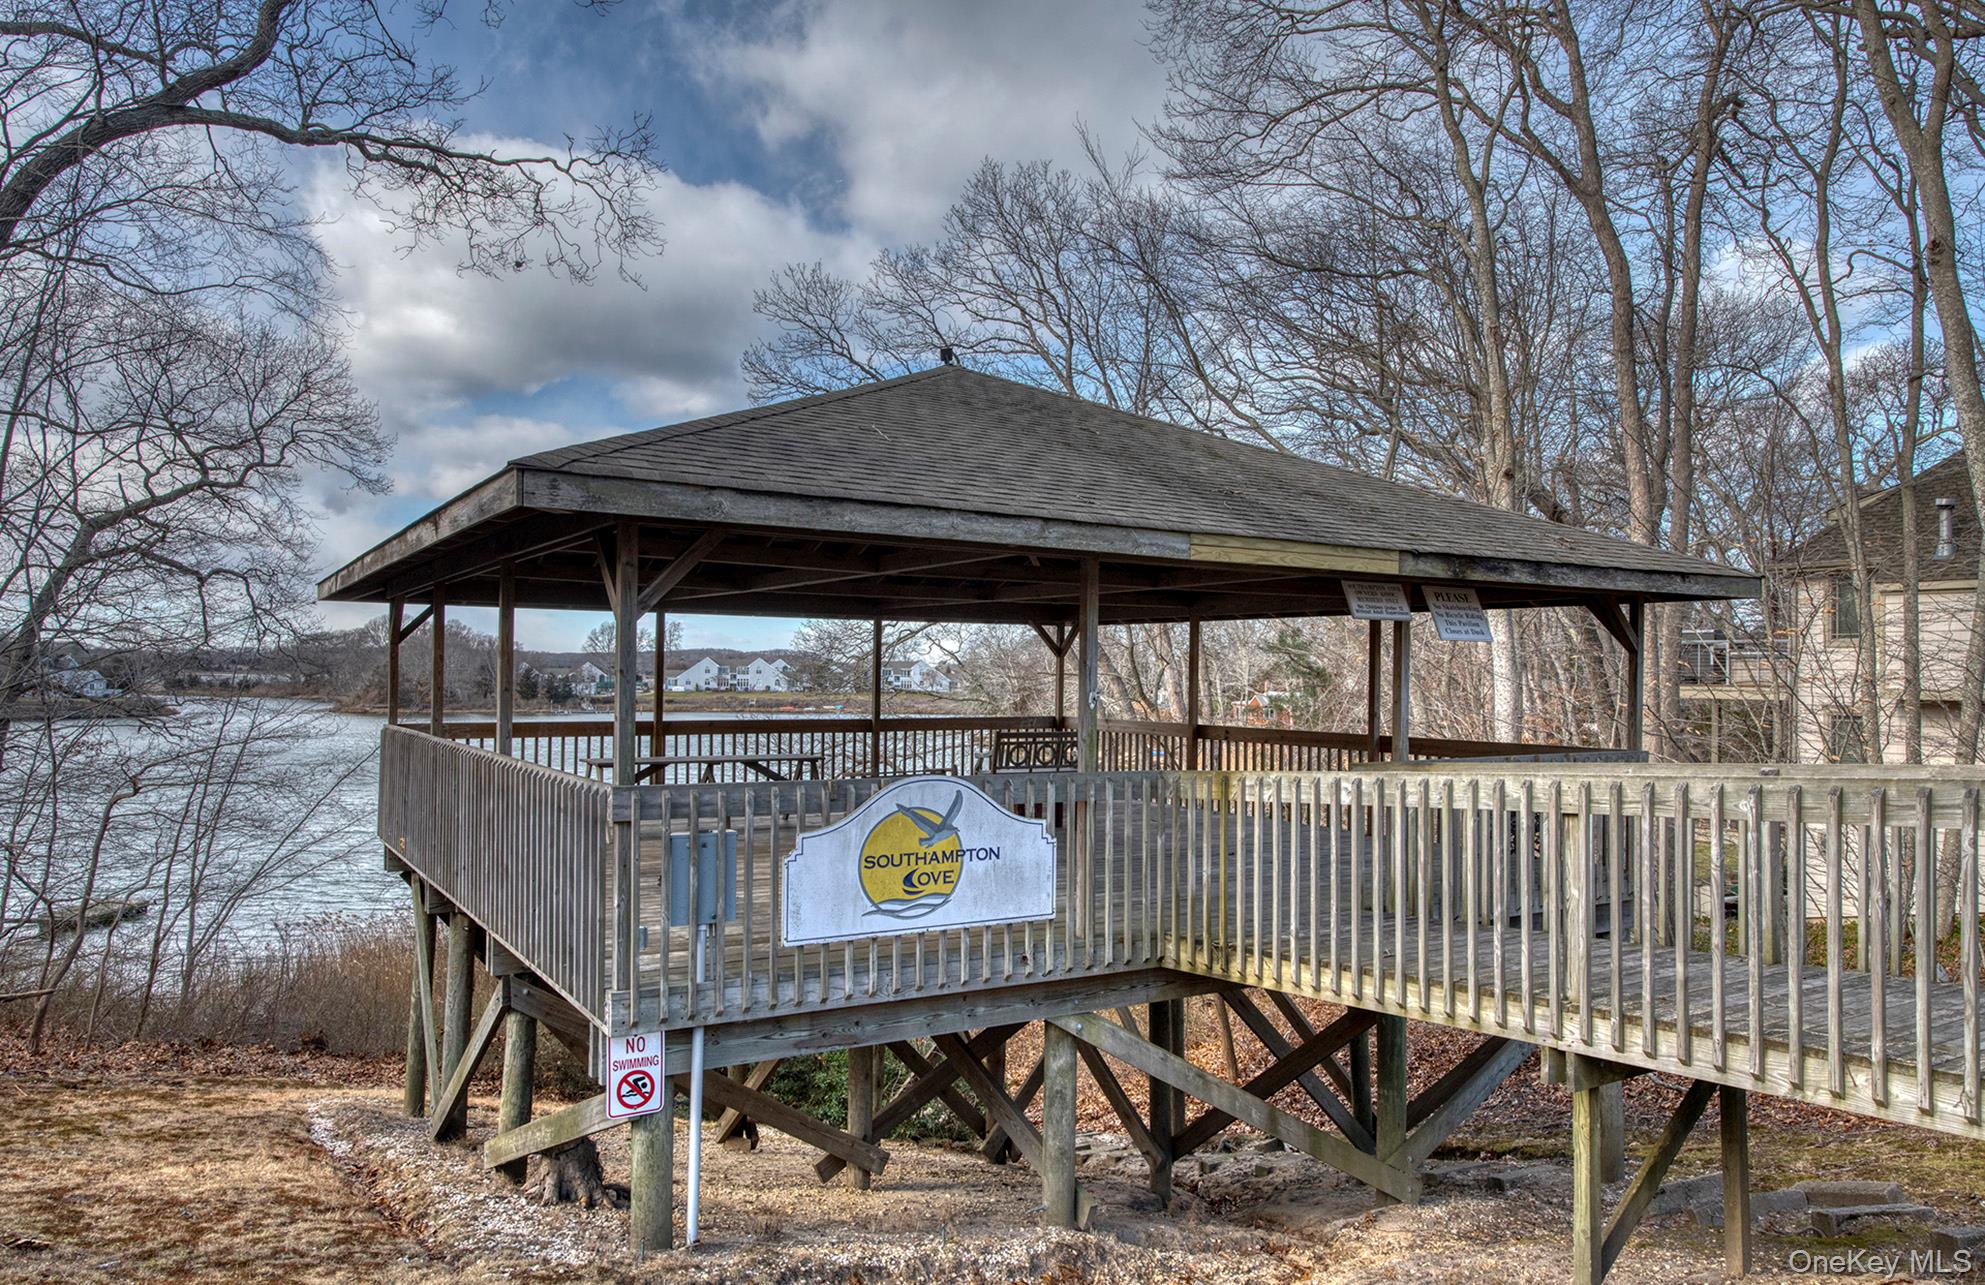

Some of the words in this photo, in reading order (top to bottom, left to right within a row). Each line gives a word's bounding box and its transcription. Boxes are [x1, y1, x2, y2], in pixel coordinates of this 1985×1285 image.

[1434, 592, 1471, 602] PLEASE
[1445, 627, 1463, 635] Closes
[1470, 628, 1485, 636] Dusk
[863, 846, 1001, 870] SOUTHAMPTON
[902, 867, 955, 890] COVE
[625, 1036, 646, 1054] NO
[613, 1055, 659, 1071] SWIMMING
